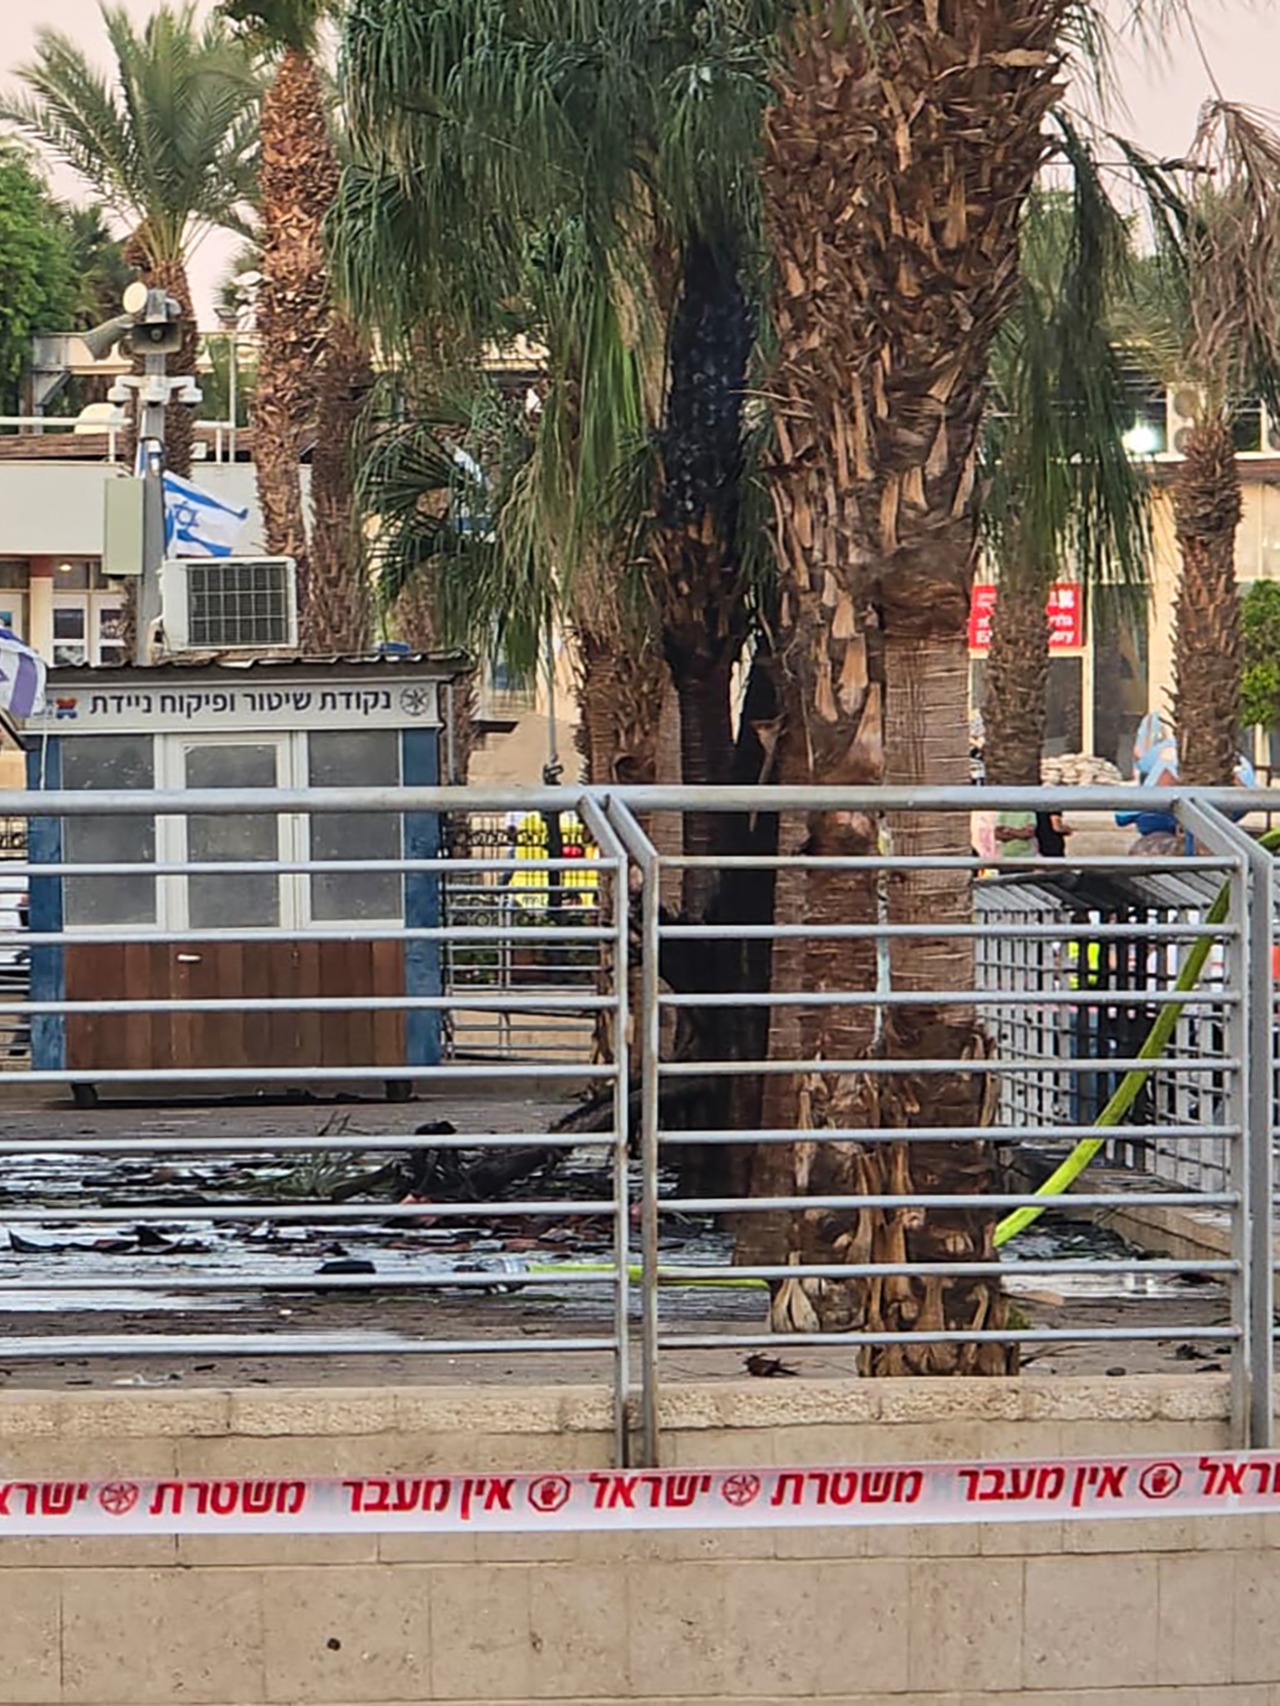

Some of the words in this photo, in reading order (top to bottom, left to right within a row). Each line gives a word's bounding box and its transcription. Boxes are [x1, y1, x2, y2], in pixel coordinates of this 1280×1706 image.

[89, 694, 153, 715] ניידת
[160, 693, 236, 719] ופיקוח
[243, 692, 312, 712] שיטור
[318, 690, 392, 716] נקודת
[148, 1480, 306, 1515] משטרת
[343, 1478, 451, 1512] מעבר
[461, 1477, 517, 1520] אין
[586, 1473, 711, 1509] ישראל
[769, 1470, 923, 1506] משטרת
[958, 1465, 1066, 1502] מעבר
[1072, 1463, 1128, 1508] אין
